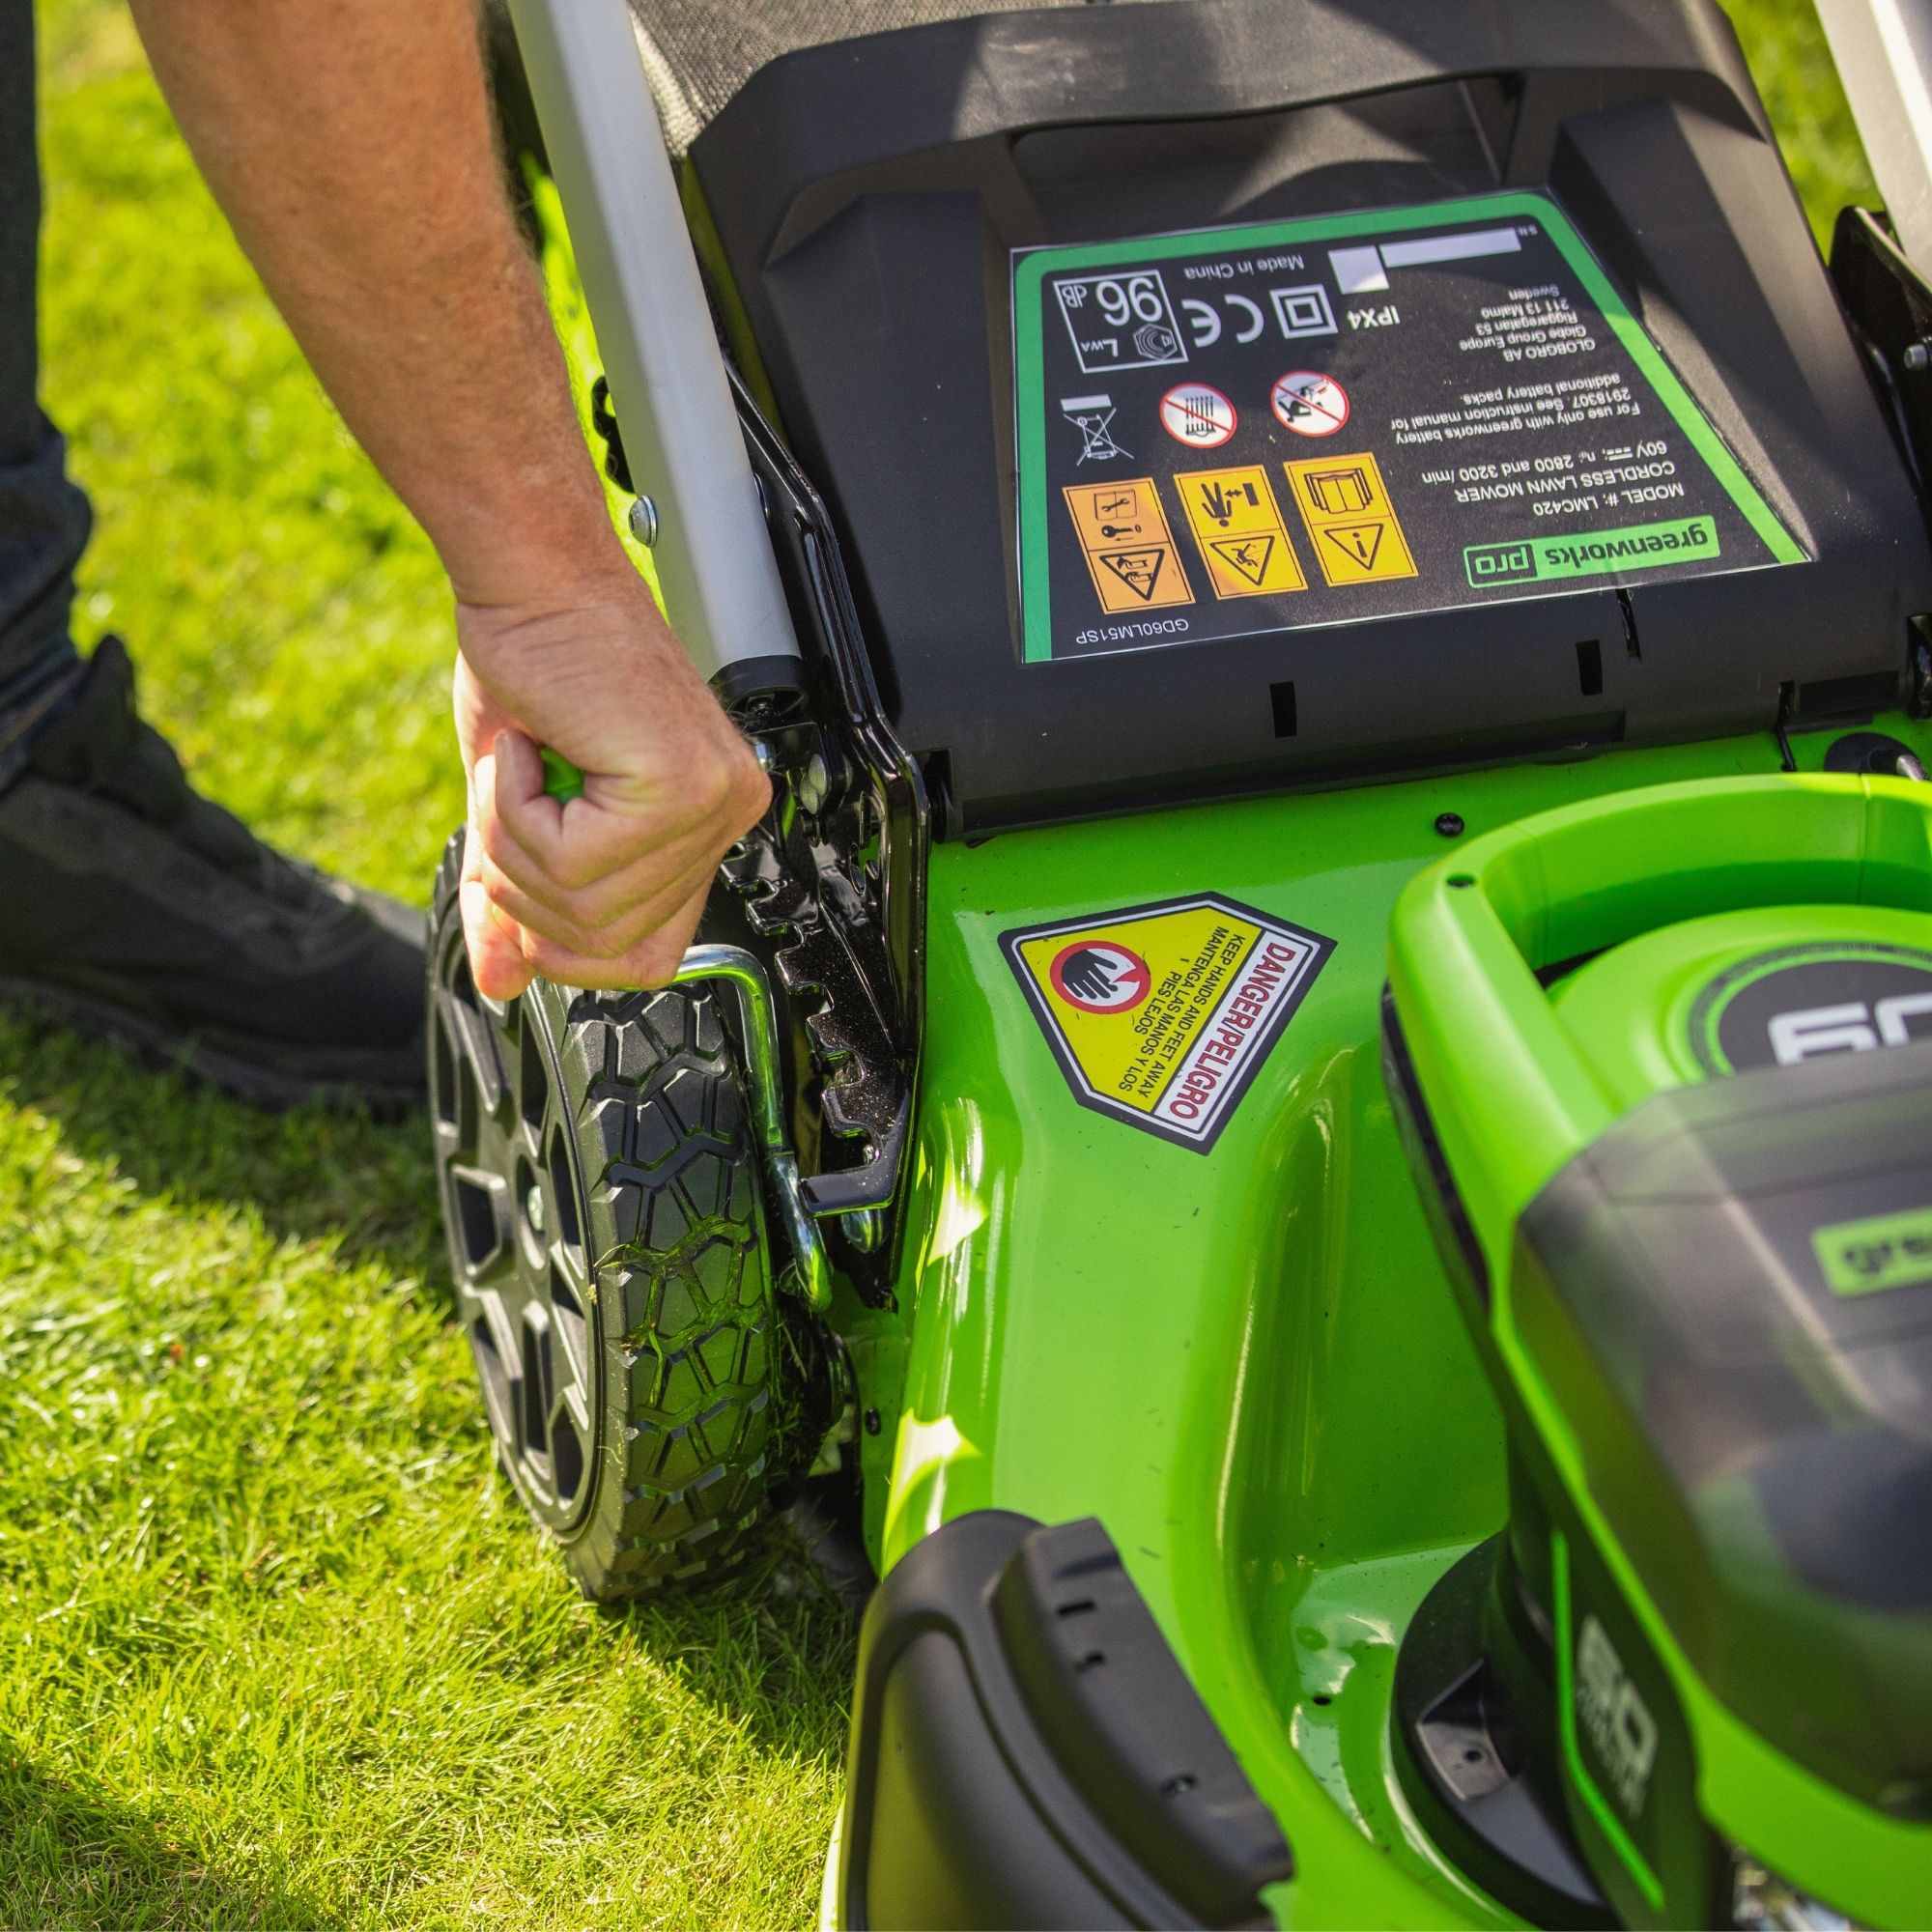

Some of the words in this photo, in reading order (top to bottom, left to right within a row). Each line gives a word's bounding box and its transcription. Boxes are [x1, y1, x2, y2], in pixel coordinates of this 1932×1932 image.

[1183, 263, 1235, 280] China
[1236, 260, 1255, 275] in
[1257, 254, 1305, 272] Made
[1061, 284, 1088, 308] dB
[1095, 272, 1163, 327] 96
[1507, 285, 1560, 301] Sweden
[1524, 300, 1542, 315] 13
[1545, 298, 1570, 314] 211
[1347, 304, 1401, 329] IPX4
[1493, 310, 1578, 331] Riggaregatan
[1475, 322, 1492, 336] 53
[1506, 329, 1547, 345] Group
[1548, 324, 1587, 340] Globe
[1459, 335, 1506, 352] Europe
[1524, 337, 1596, 359] GLOBGRO
[1502, 347, 1522, 362] AB
[1506, 383, 1554, 400] battery
[1554, 372, 1621, 395] additional
[1460, 387, 1504, 406] packs.
[1536, 397, 1565, 412] See
[1463, 402, 1534, 421] instruction
[1556, 406, 1585, 426] only
[1587, 406, 1613, 419] use
[1616, 401, 1641, 416] For
[1391, 417, 1409, 434] for
[1410, 411, 1462, 430] manual
[1443, 415, 1523, 440] greenworks
[1524, 414, 1555, 431] with
[1396, 429, 1443, 444] battery
[1636, 440, 1667, 459] 60V
[1459, 464, 1499, 482] 3200
[1500, 460, 1531, 477] and
[1534, 454, 1575, 473] 2800
[1421, 469, 1455, 486] /min
[1579, 460, 1676, 488] CORDLESS
[1454, 481, 1524, 503] MOWER
[1526, 474, 1578, 495] LAWN
[1621, 482, 1685, 504] MODEL
[1532, 496, 1599, 517] LMC420
[1603, 492, 1619, 507] #:
[1544, 523, 1709, 569] greenworks
[1474, 546, 1531, 575] pro
[1075, 618, 1189, 644] GD60LM51SP
[1180, 925, 1230, 988] MANTENGA
[1219, 933, 1246, 966] KEEP
[1157, 971, 1183, 998] PIES
[1192, 965, 1227, 1006] HANDS
[1166, 988, 1191, 1013] LAS
[1134, 997, 1166, 1036] LEJOS
[1178, 1004, 1201, 1031] AND
[1140, 1012, 1176, 1056] MANOS
[1170, 942, 1297, 1120] DANGER/PELIGRO
[1769, 992, 1932, 1065] 6
[1158, 1030, 1186, 1063] FEET
[1134, 1057, 1150, 1067] Y
[1118, 1065, 1143, 1092] LOS
[1137, 1060, 1166, 1098] AWAY
